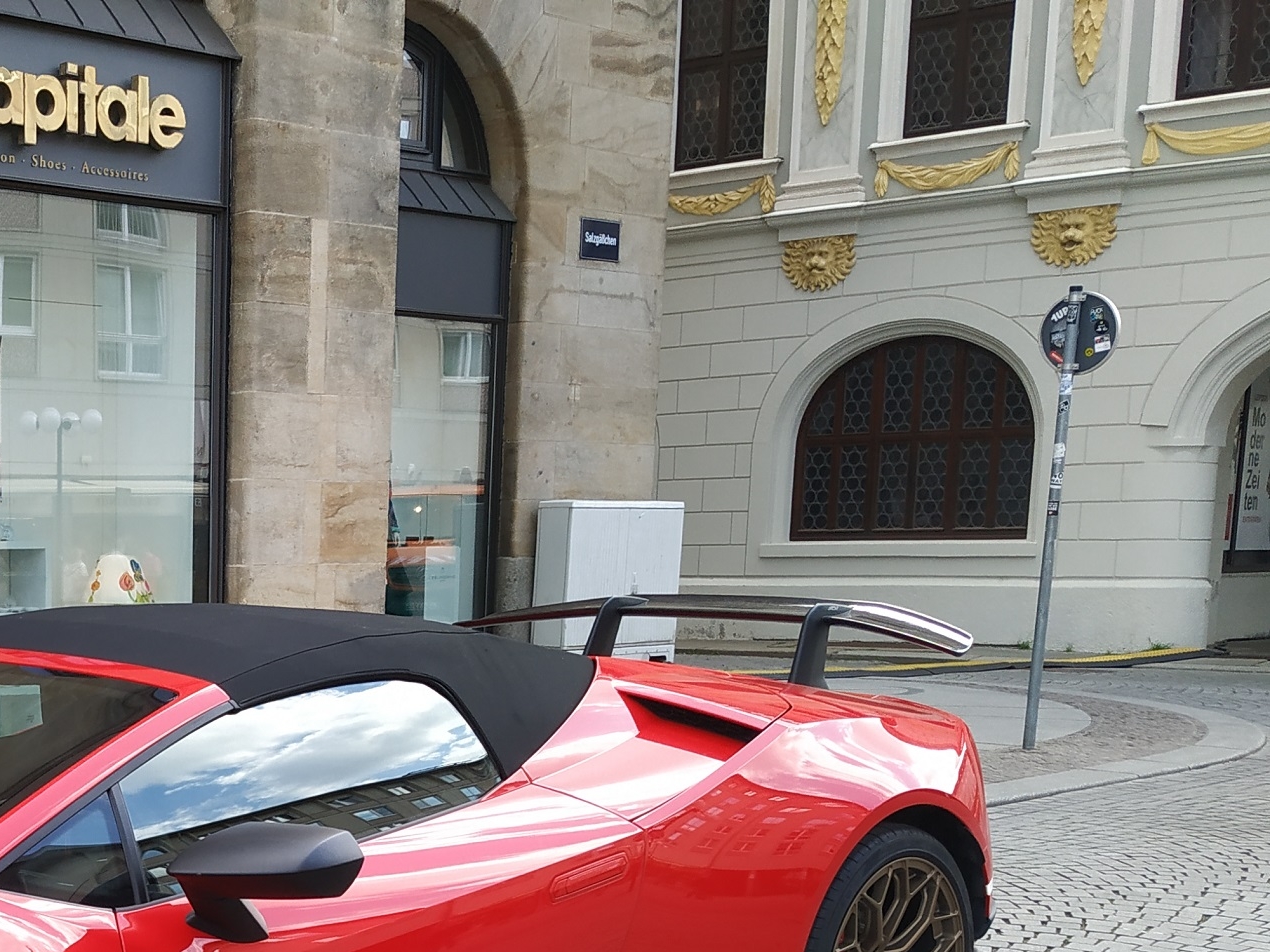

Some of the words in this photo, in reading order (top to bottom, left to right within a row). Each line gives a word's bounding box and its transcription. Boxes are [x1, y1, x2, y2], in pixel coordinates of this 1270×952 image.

[31, 154, 67, 171] Shoes
[81, 161, 149, 182] Accessoires
[1252, 406, 1267, 428] Mo
[1248, 452, 1260, 467] ne
[1245, 469, 1261, 489] Zei
